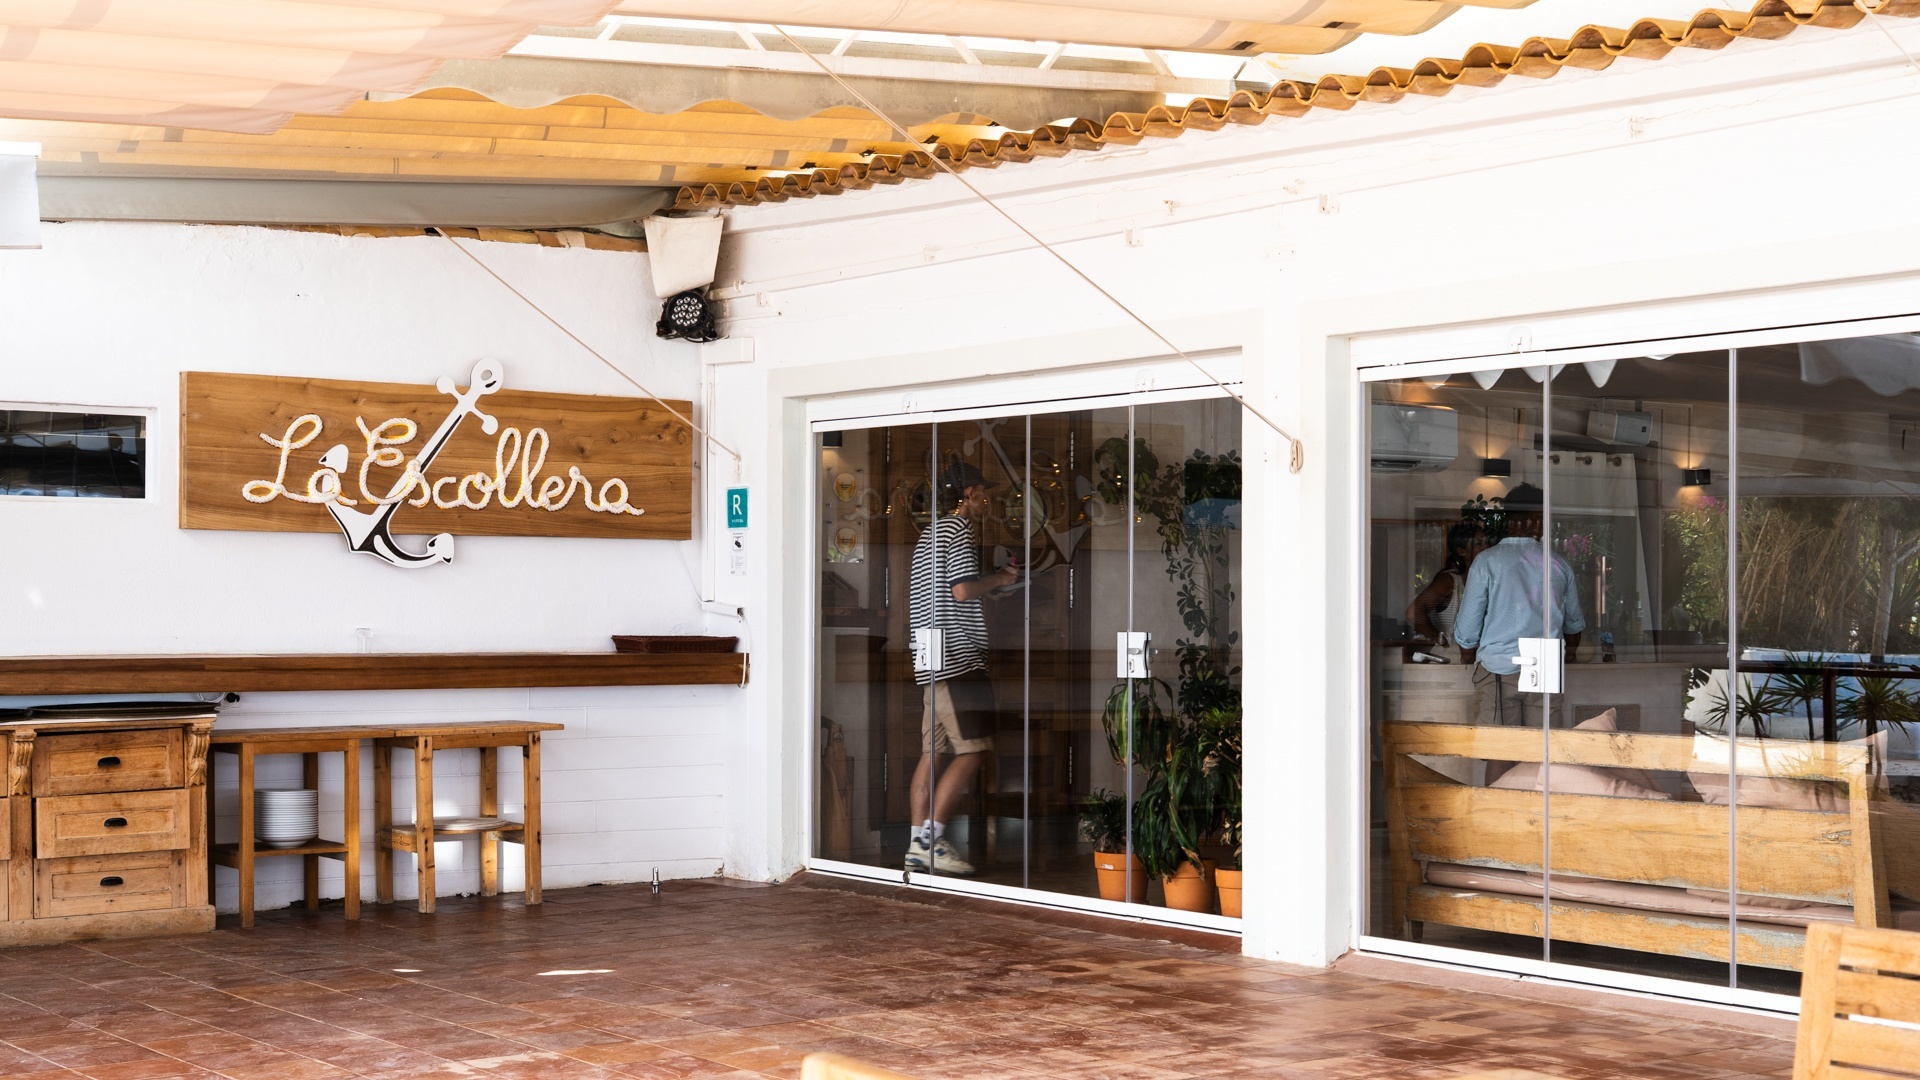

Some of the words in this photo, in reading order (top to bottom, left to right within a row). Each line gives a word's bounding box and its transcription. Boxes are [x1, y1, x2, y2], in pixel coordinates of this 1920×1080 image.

[242, 414, 358, 506] La
[356, 415, 646, 516] Escollera
[732, 494, 743, 516] R
